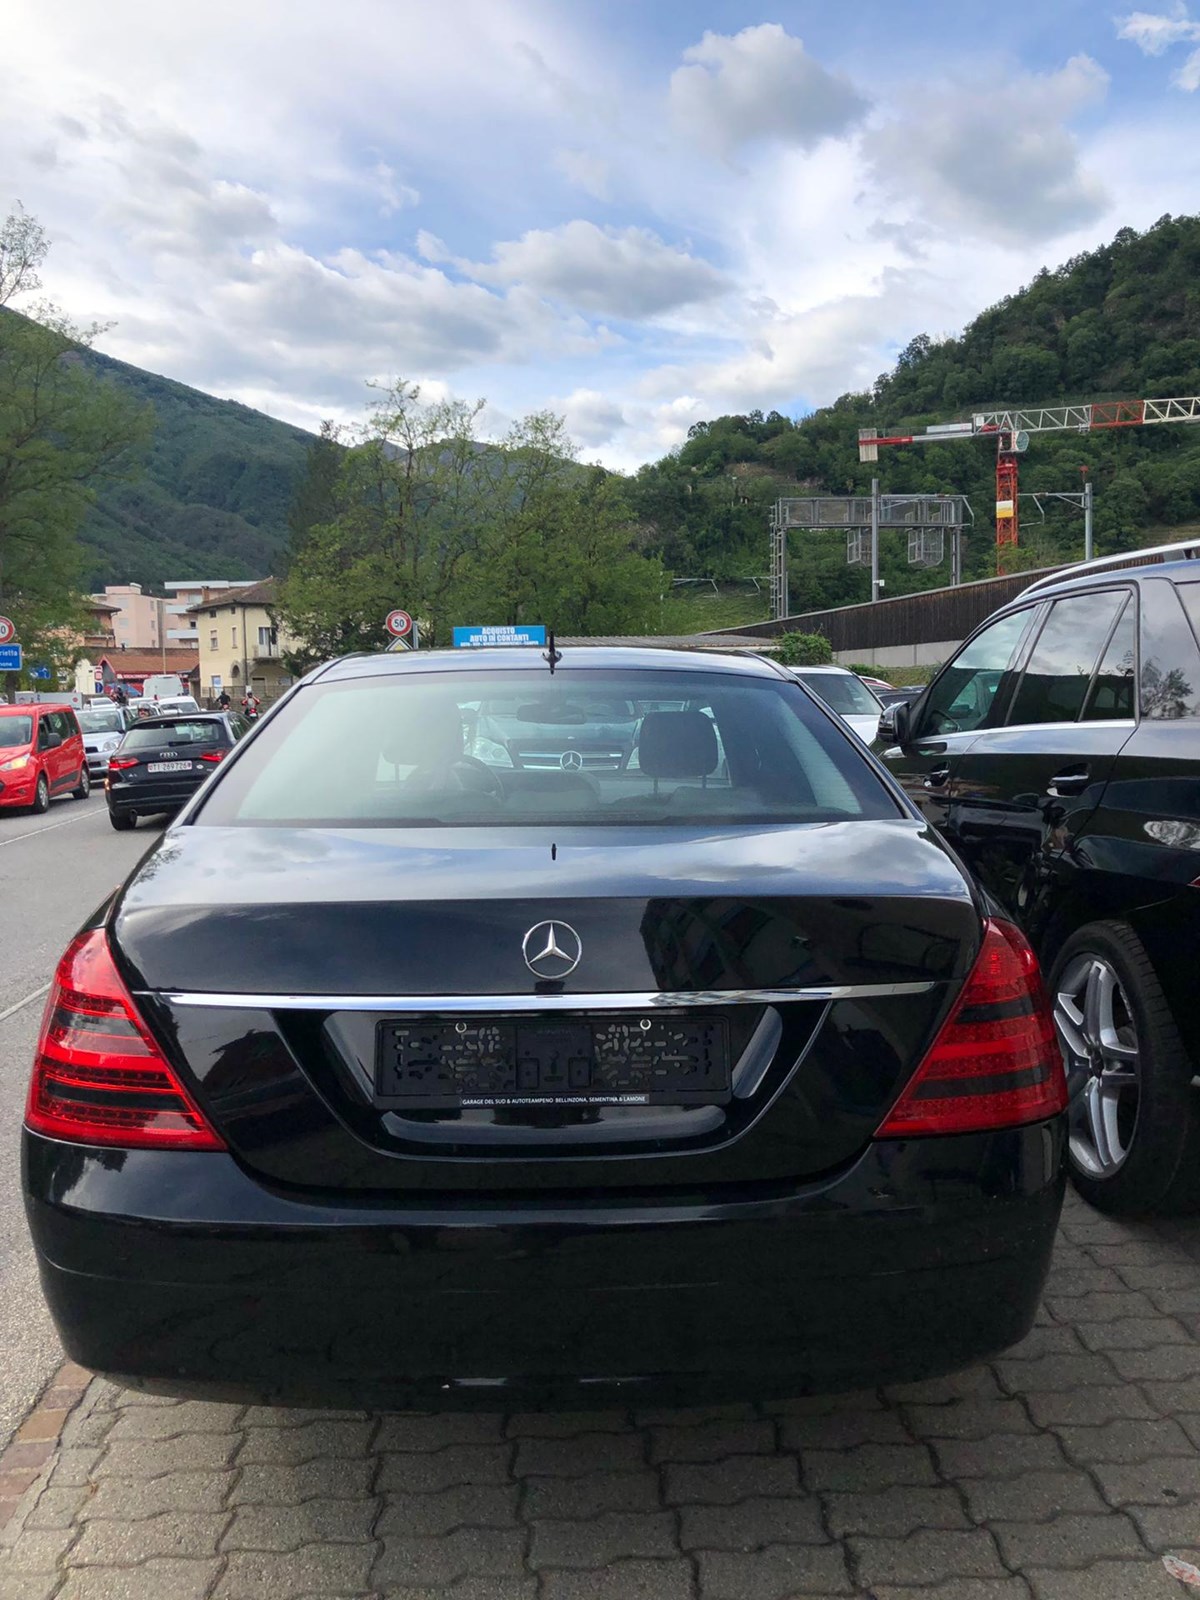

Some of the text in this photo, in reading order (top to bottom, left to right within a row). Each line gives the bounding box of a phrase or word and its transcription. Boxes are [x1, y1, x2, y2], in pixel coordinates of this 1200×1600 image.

[394, 619, 405, 628] 50
[482, 627, 515, 635] ACQUISTO
[496, 634, 529, 642] CONTANTI
